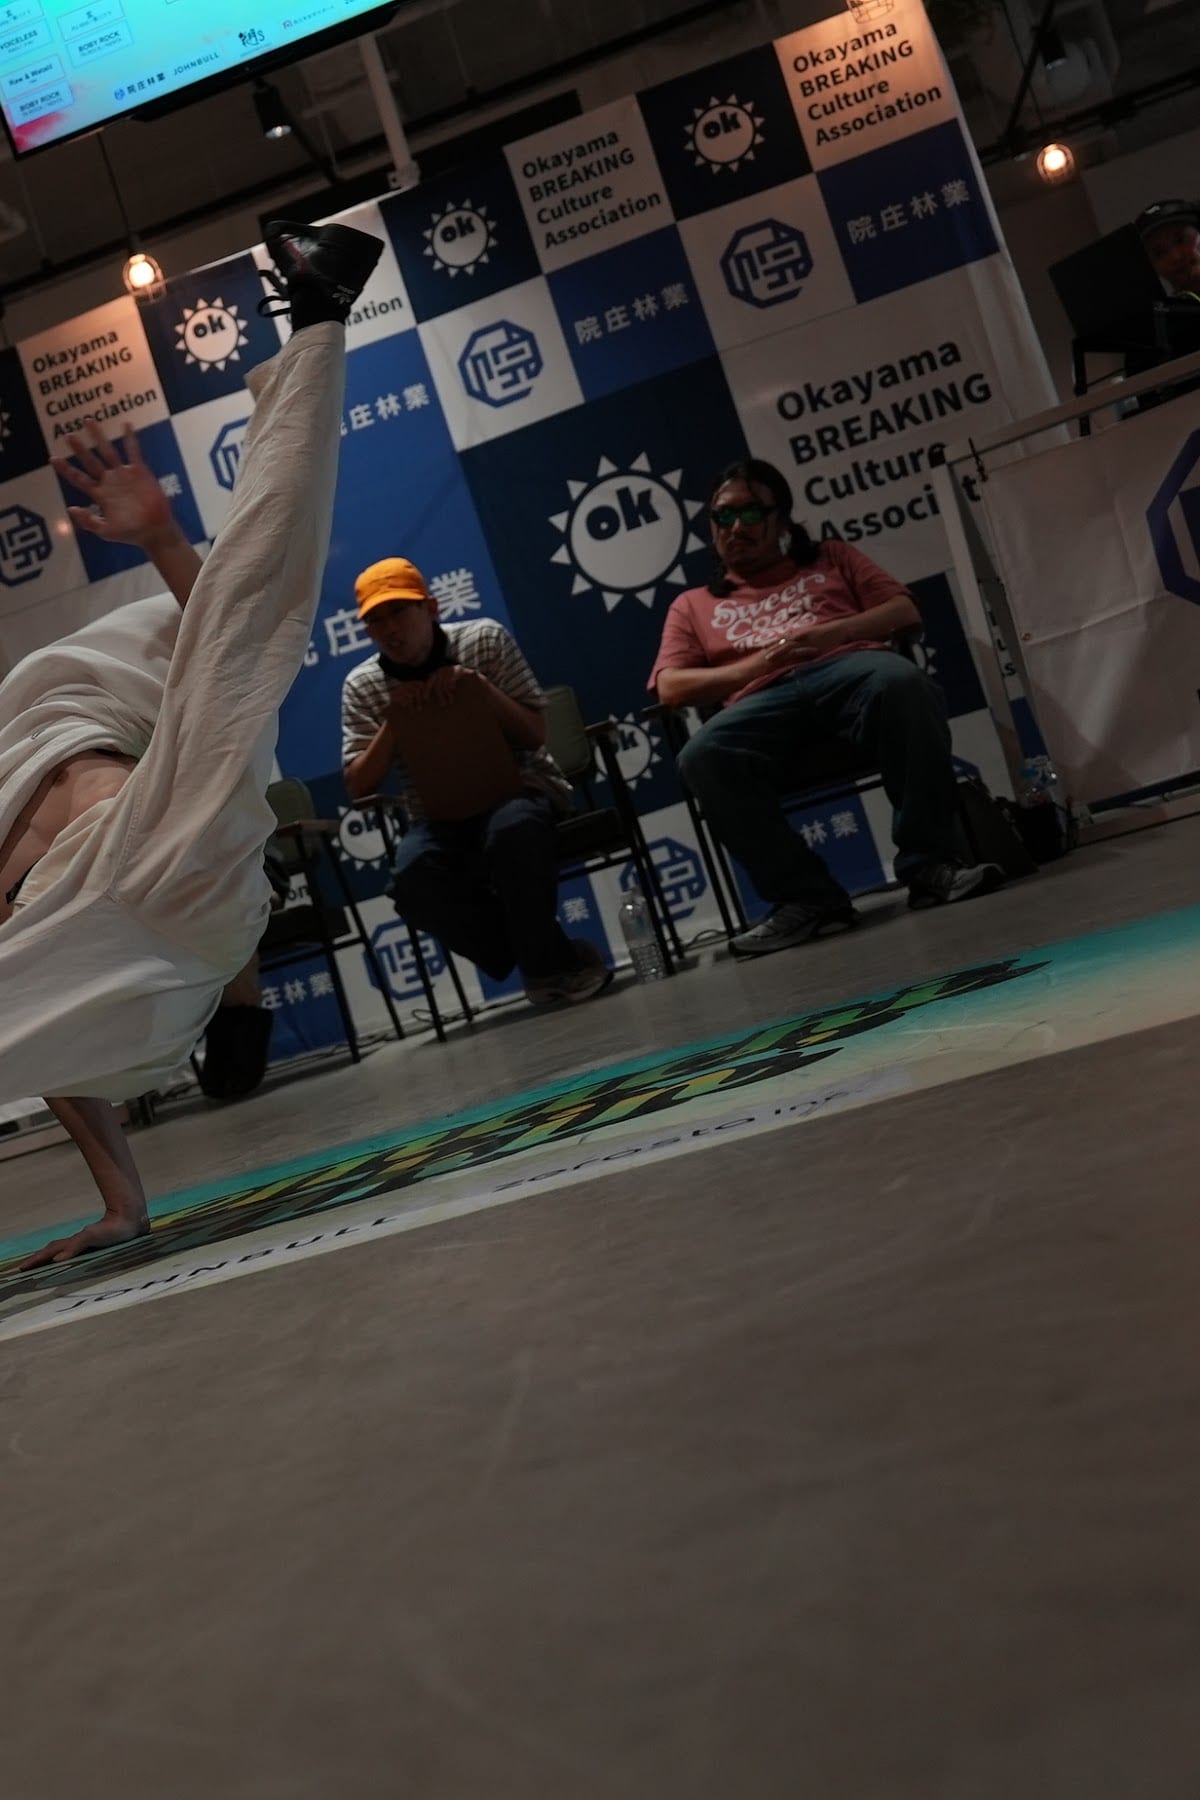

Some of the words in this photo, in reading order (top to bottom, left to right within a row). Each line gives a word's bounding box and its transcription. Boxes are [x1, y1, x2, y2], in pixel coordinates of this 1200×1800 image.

[173, 52, 220, 75] JOHNBULL
[793, 22, 898, 74] Okayama
[800, 39, 914, 98] BREAKING
[703, 111, 741, 139] ok
[807, 80, 890, 121] Culture
[816, 85, 942, 147] Association
[522, 131, 620, 180] Okayama
[530, 148, 636, 202] BREAKING
[439, 215, 476, 244] ok
[536, 184, 613, 225] Culture
[544, 190, 662, 250] Association
[847, 179, 970, 245] 院庄林業
[194, 313, 226, 339] ok
[574, 282, 689, 346] 院庄林業
[32, 330, 119, 373] Okayama
[39, 347, 133, 396] BREAKING
[46, 381, 113, 417] Culture
[777, 341, 962, 421] Okayama
[340, 383, 430, 437] 庄林業
[789, 373, 993, 466] BREAKING
[585, 485, 661, 542] ok
[711, 573, 826, 629] Sweet
[261, 972, 336, 1009] 庄林業
[56, 1218, 388, 1312] JOHNBULL
